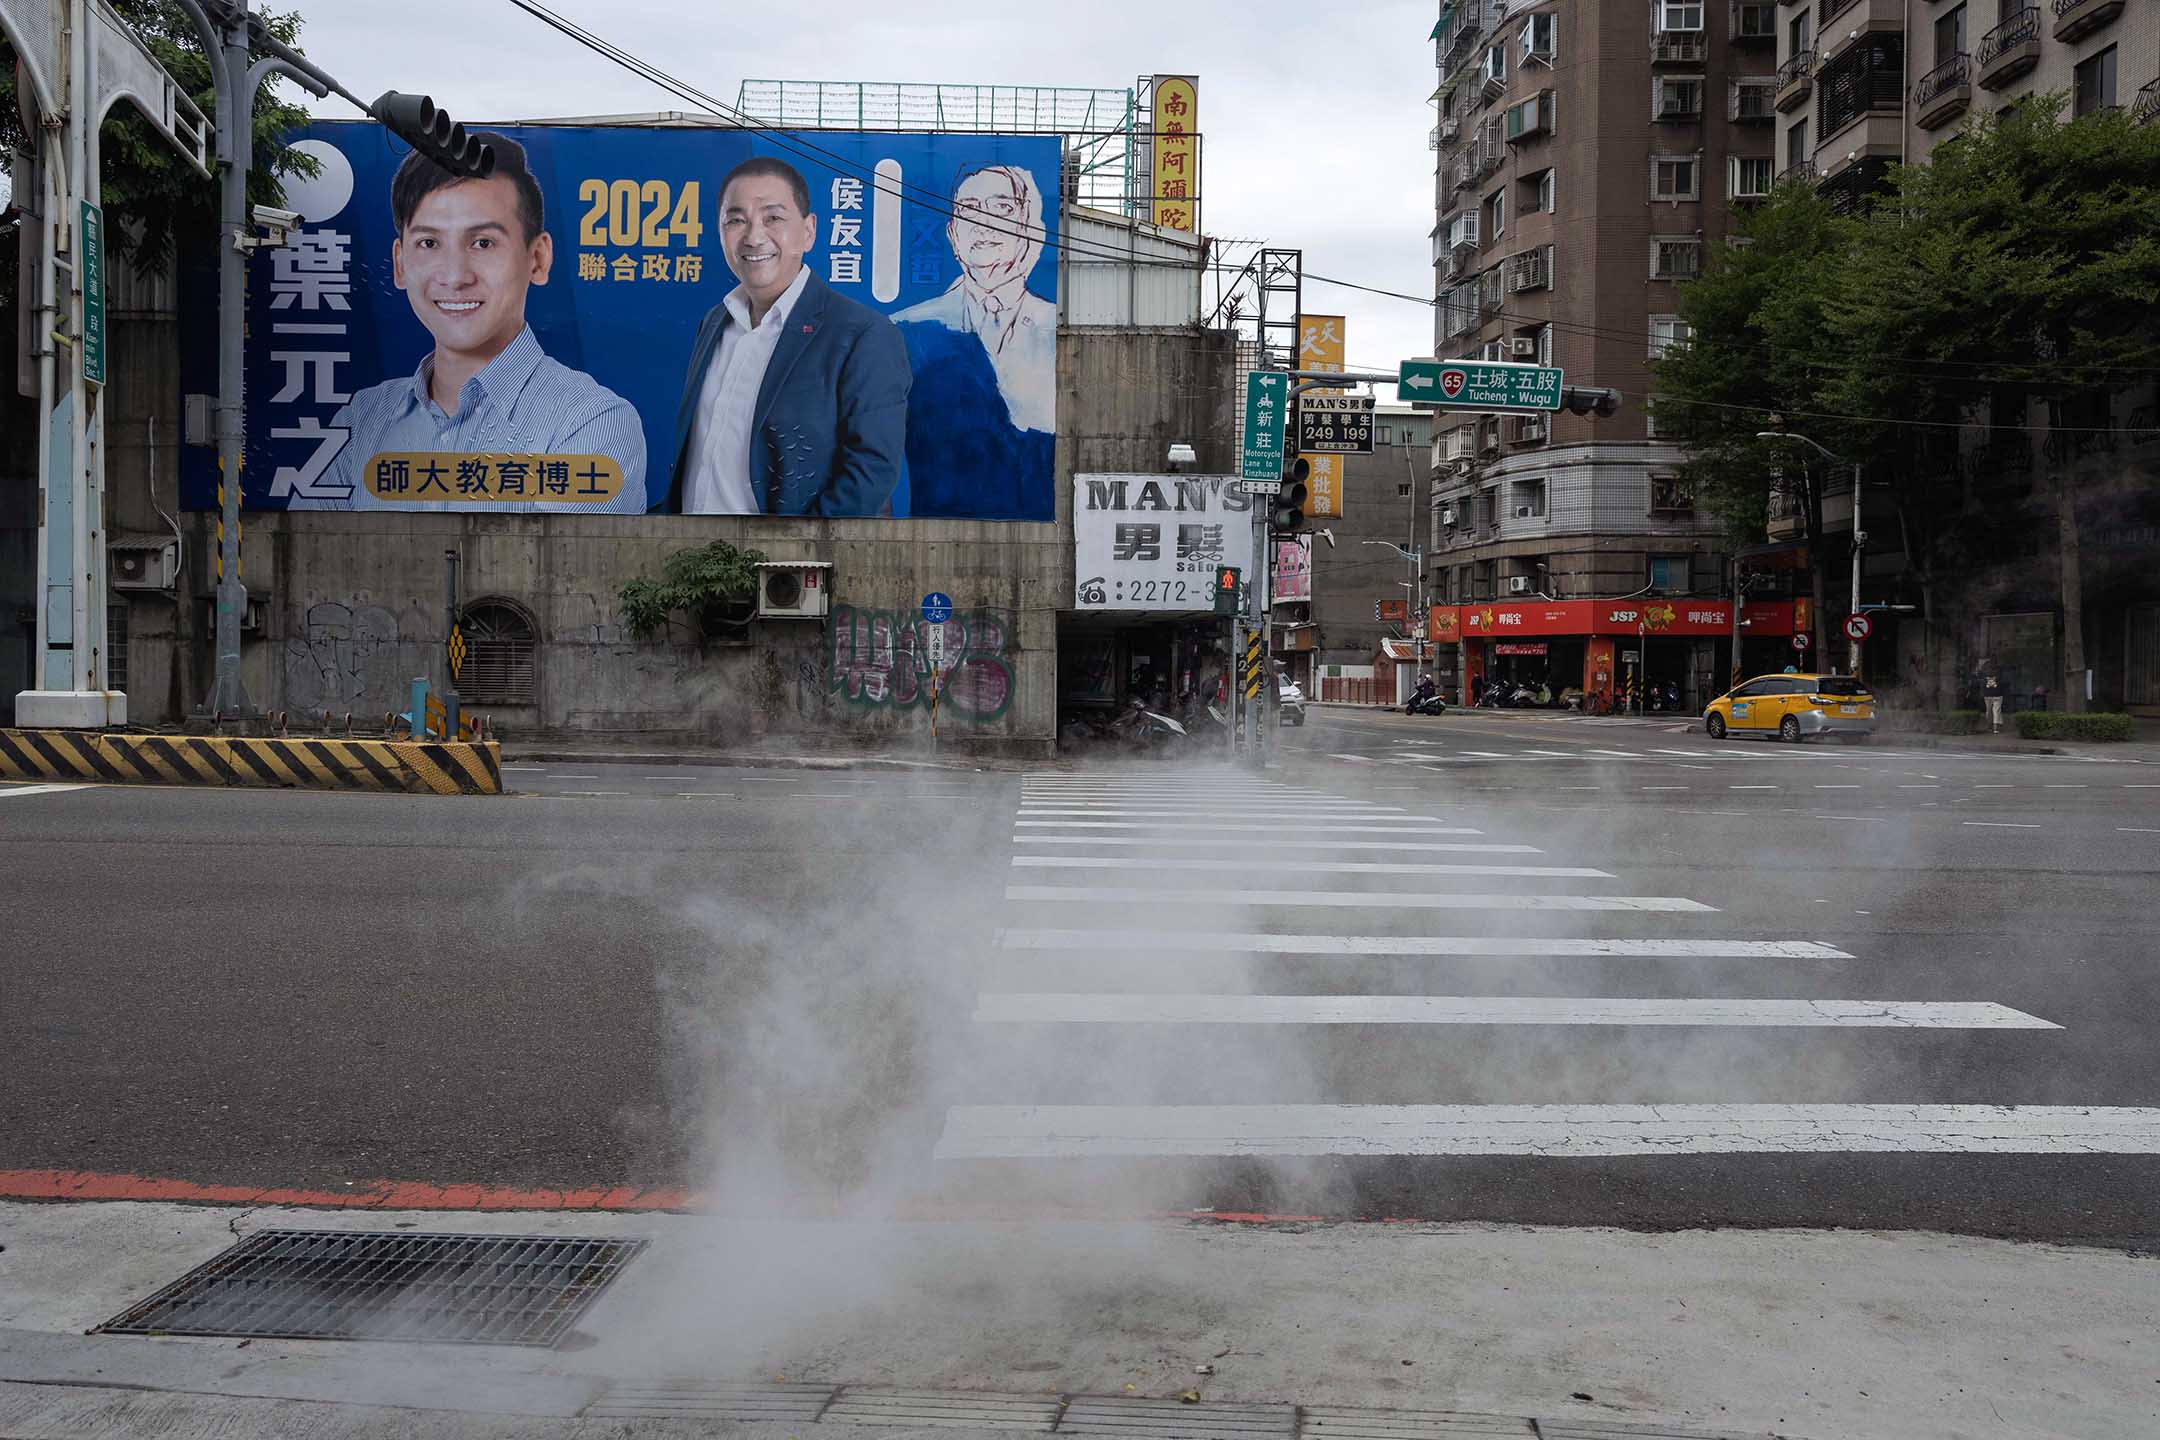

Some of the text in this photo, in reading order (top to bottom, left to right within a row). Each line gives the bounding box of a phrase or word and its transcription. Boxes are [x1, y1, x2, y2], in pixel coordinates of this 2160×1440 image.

[579, 179, 703, 247] 2024
[829, 177, 863, 283] 侯友宜
[578, 252, 703, 282] 聯合政府
[269, 229, 354, 497] 葉元之
[1443, 375, 1461, 388] 65
[1303, 399, 1348, 409] MAN'S
[1468, 389, 1551, 407] Tucheng Wugu
[1256, 411, 1273, 448] 新莊
[1305, 427, 1368, 440] 249 199
[1245, 449, 1281, 459] Motorcycle
[1265, 460, 1273, 468] to
[376, 459, 610, 496] 師大教育博士
[1244, 470, 1279, 480] Xinzhuang
[1085, 479, 1252, 512] MAN'S
[1609, 610, 1639, 622] JSP
